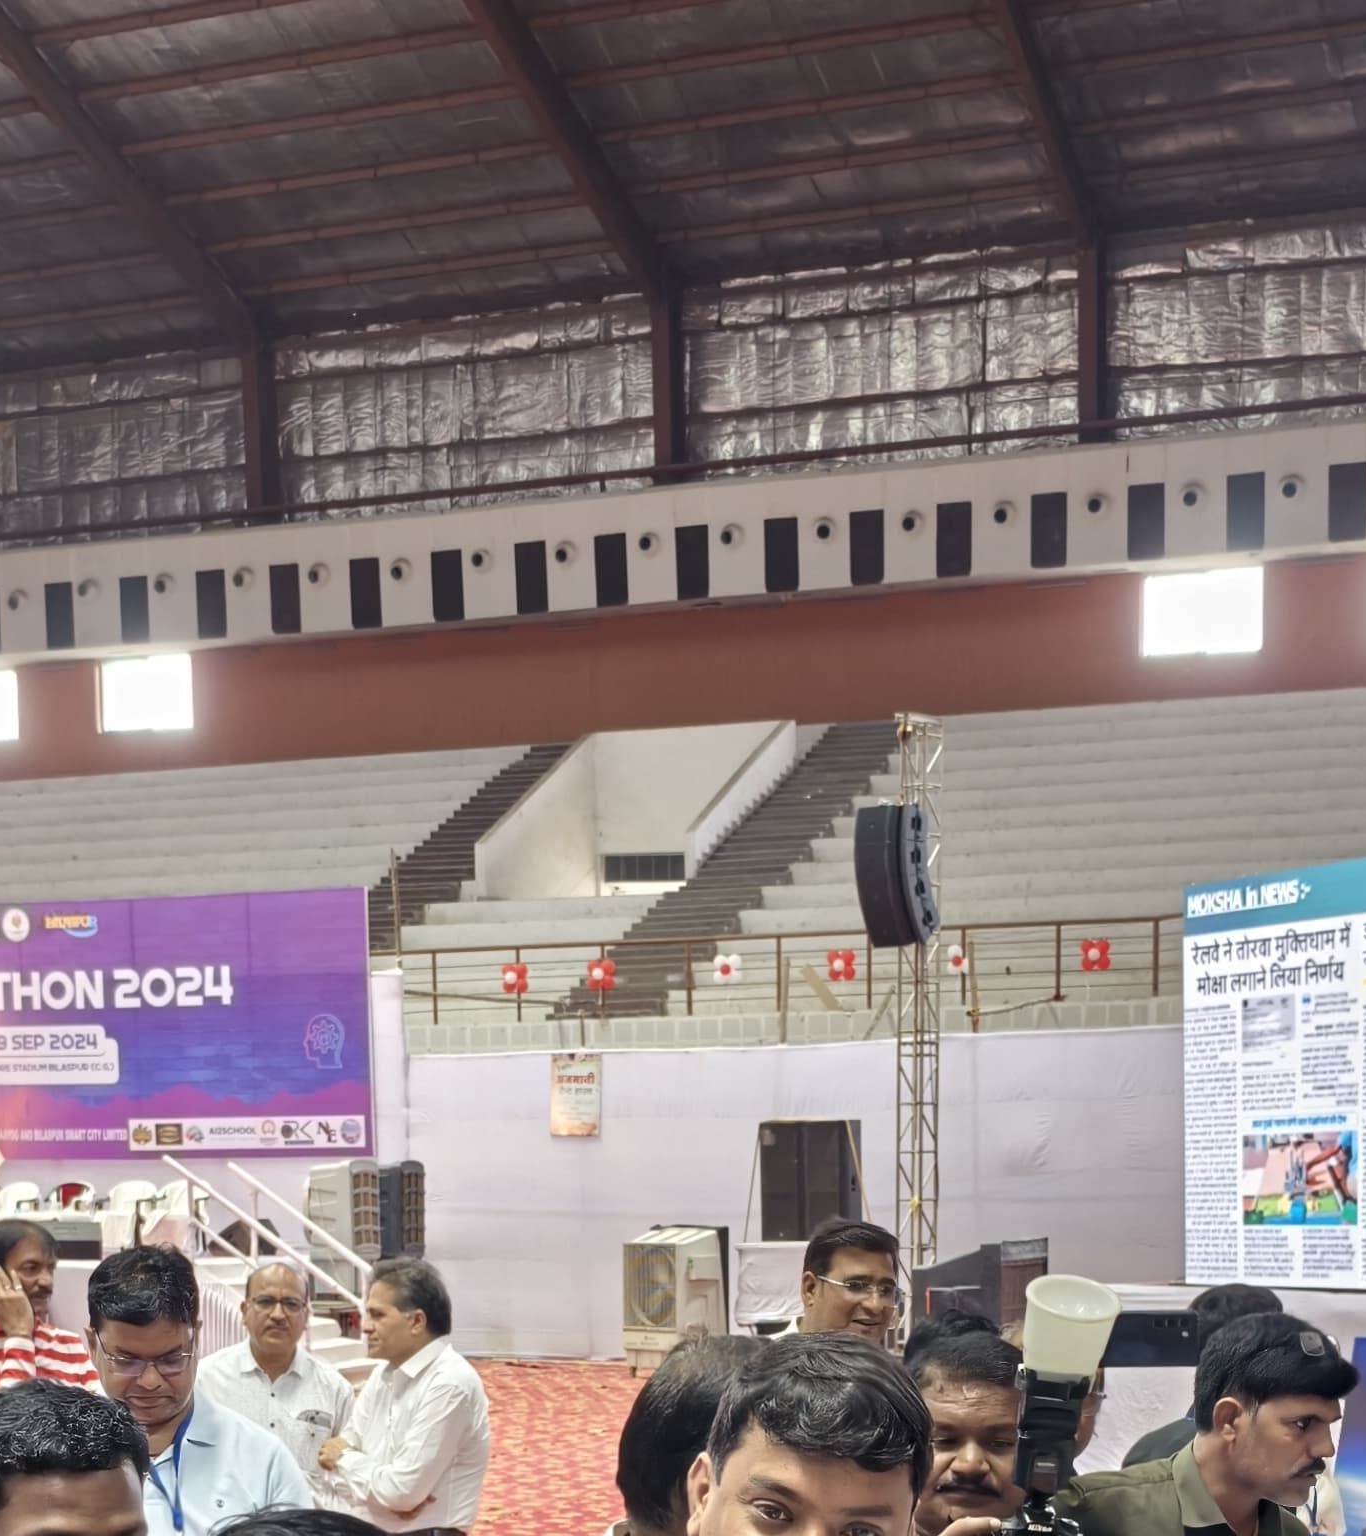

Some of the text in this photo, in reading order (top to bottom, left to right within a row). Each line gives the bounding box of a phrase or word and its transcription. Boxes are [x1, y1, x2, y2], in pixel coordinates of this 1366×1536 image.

[1187, 888, 1243, 918] MOKSHA
[1191, 922, 1352, 965] रेलवे ने तोरवा मुक्तिधाम में
[113, 965, 234, 1008] 2024
[1197, 971, 1227, 996] मोक्षा
[1230, 964, 1267, 993] लगाने
[1270, 962, 1301, 989] लिया
[1304, 954, 1345, 985] निर्णय
[11, 1033, 44, 1050] SEP
[49, 1032, 98, 1050] 2024
[12, 1063, 47, 1072] STADIUM
[48, 1062, 89, 1071] BILASPUR
[87, 1128, 102, 1141] CITY
[103, 1128, 128, 1141] LIMITED
